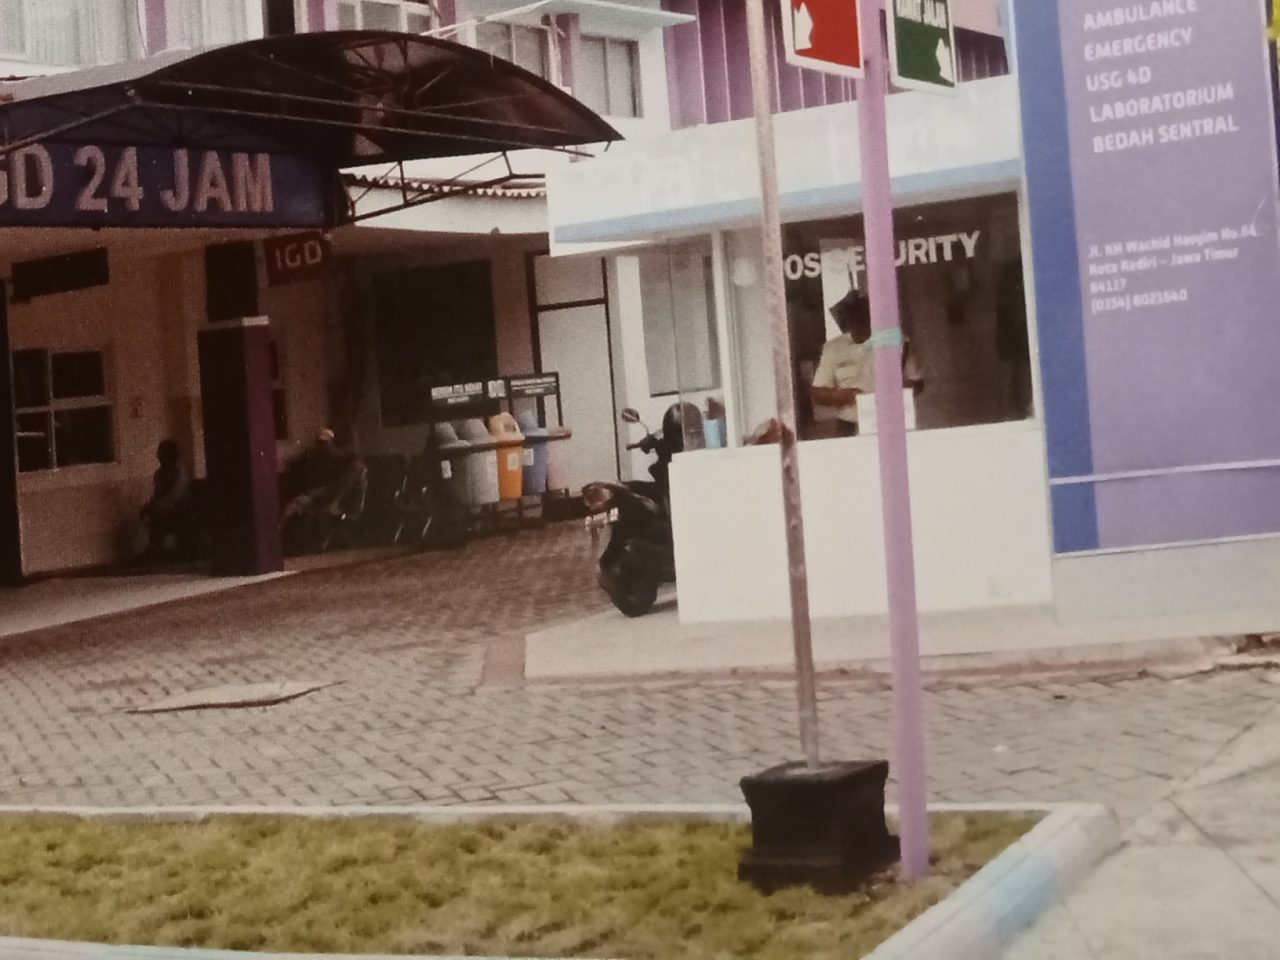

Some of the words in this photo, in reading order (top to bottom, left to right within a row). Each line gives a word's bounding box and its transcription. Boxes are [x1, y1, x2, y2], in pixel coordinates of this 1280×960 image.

[1084, 27, 1193, 61] EMERGENCY
[1086, 71, 1122, 91] USG
[1127, 66, 1152, 84] 4D
[1089, 82, 1235, 123] LABORATORIUM
[1092, 128, 1155, 153] BEDAH
[1158, 114, 1240, 143] SENTRAL
[74, 145, 144, 211] 24
[159, 148, 274, 213] JAM
[275, 240, 322, 269] IGD
[784, 253, 821, 280] OS
